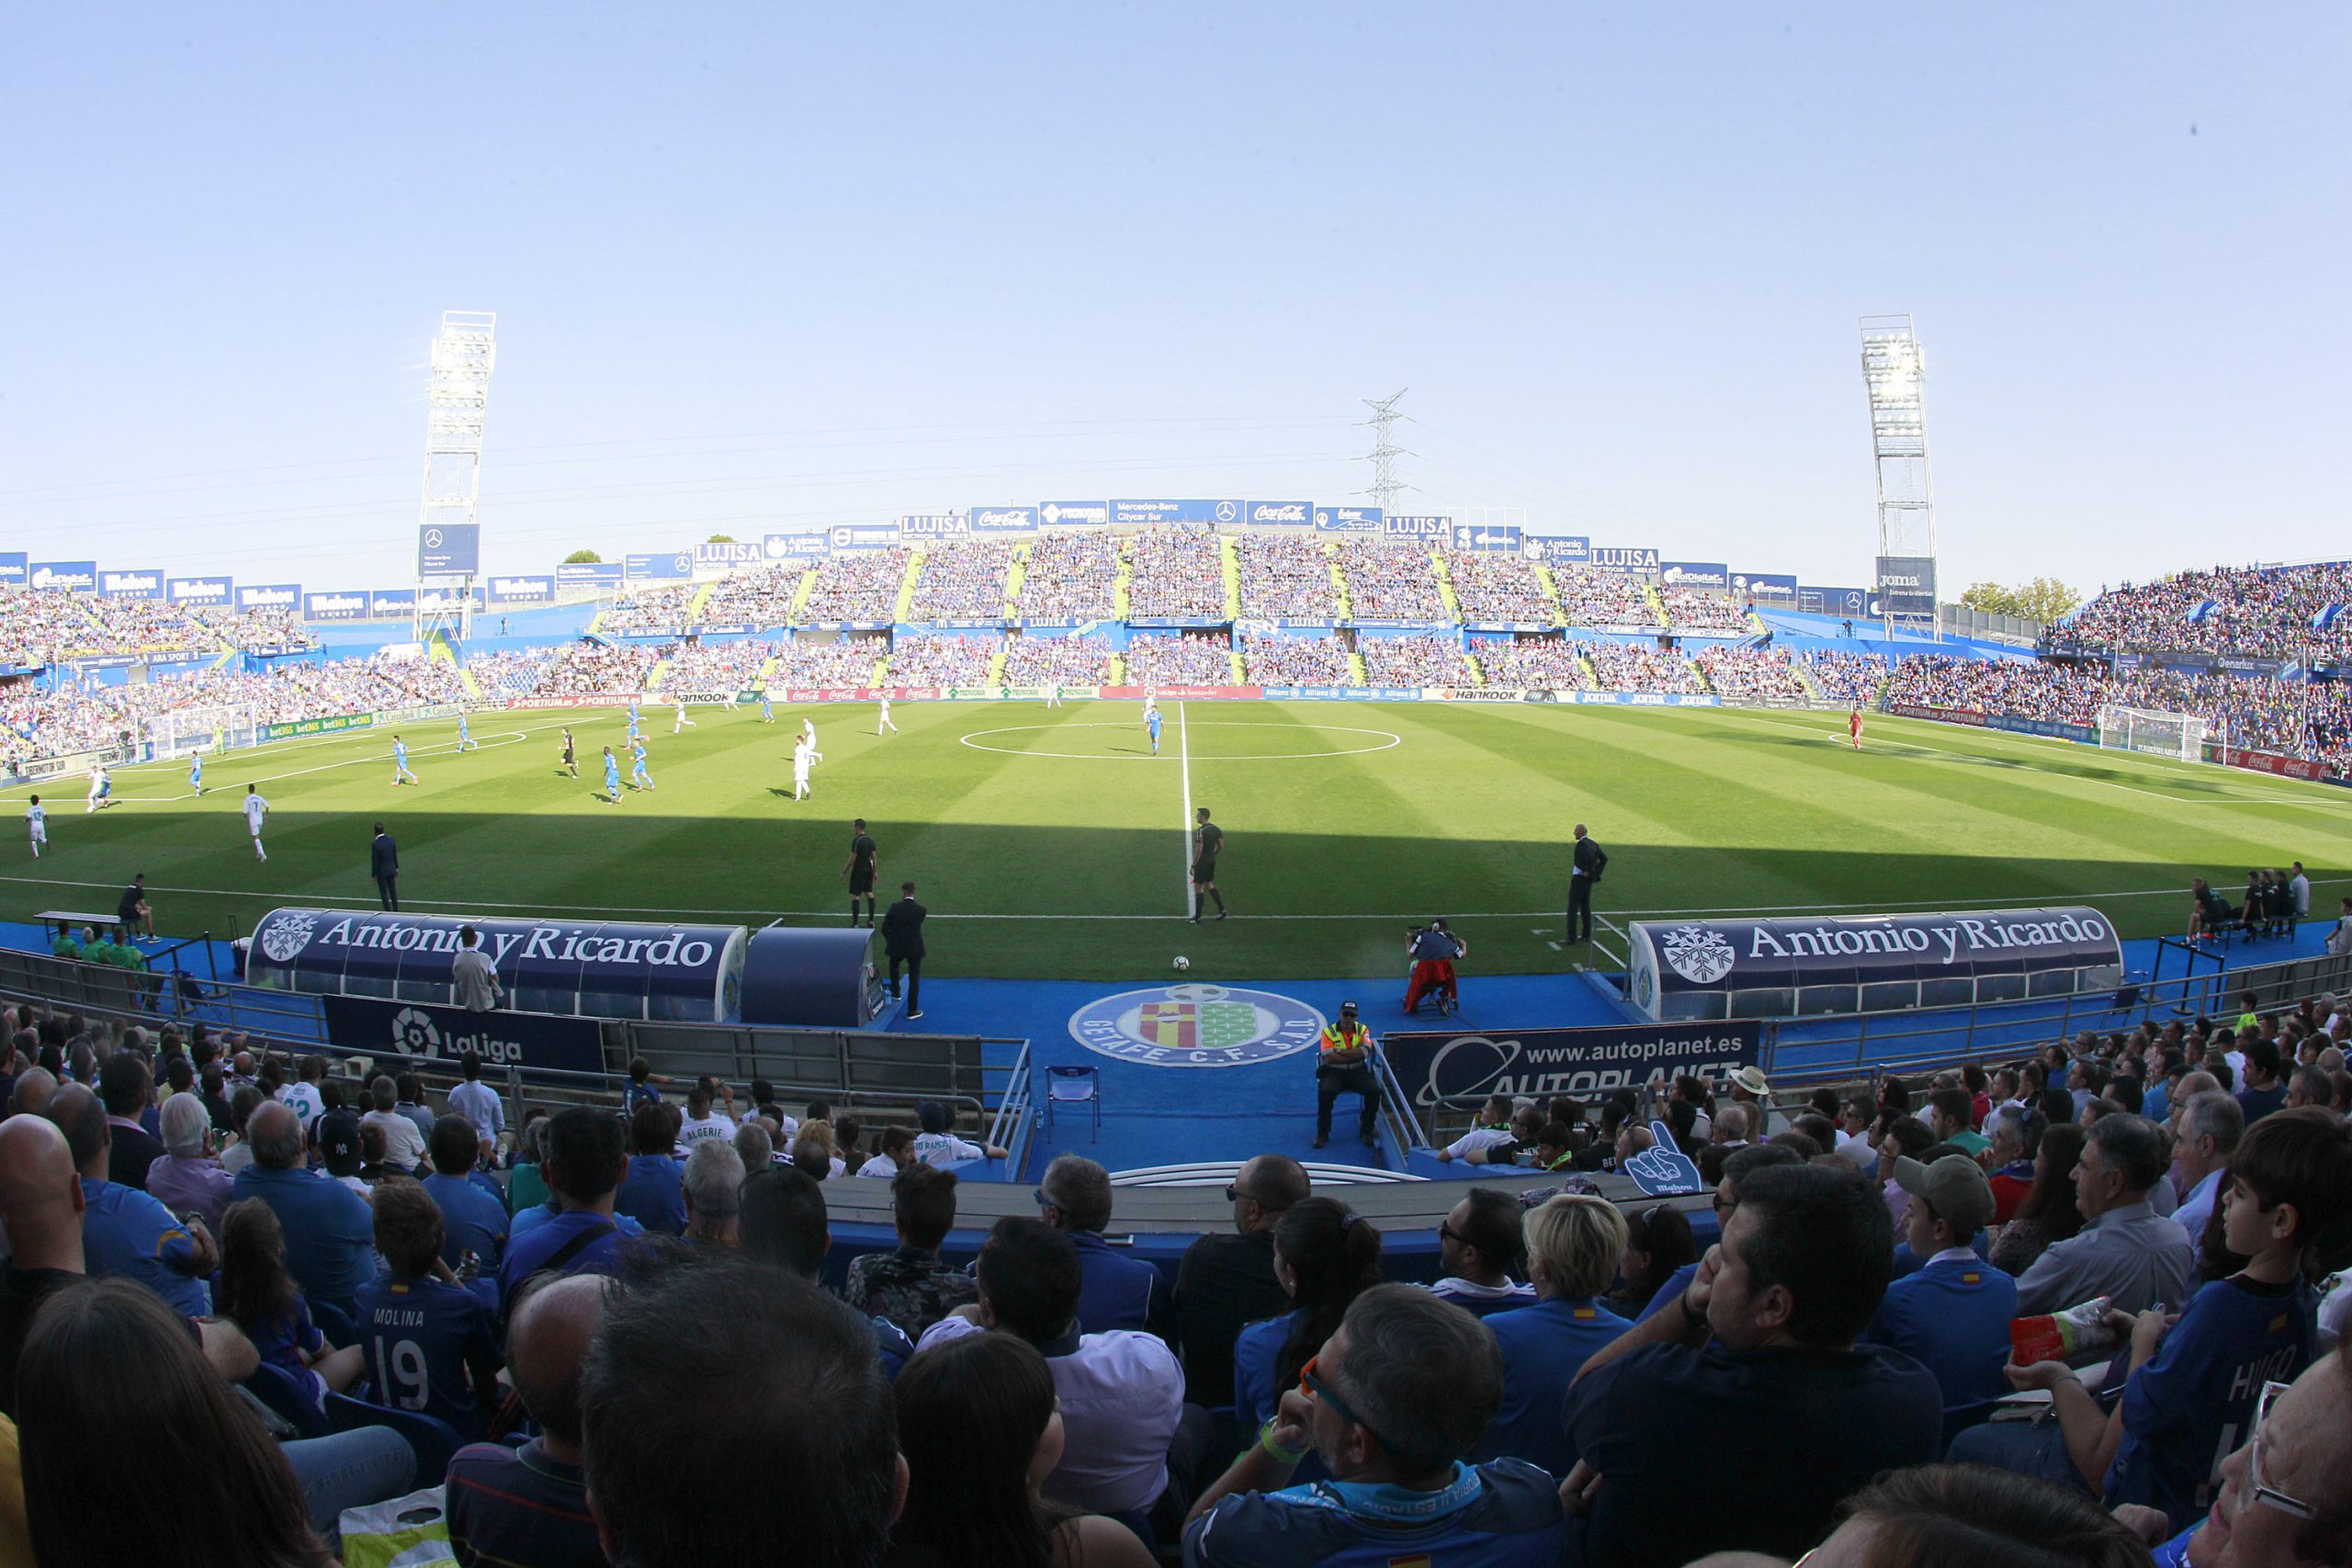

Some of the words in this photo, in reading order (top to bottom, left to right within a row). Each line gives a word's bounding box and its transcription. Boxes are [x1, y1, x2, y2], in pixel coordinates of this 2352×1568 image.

[1117, 502, 1179, 511] Mercedes-Benz
[1254, 505, 1306, 521] Coca-Cola
[902, 517, 967, 533] LUJISA
[978, 511, 1031, 526] Coca-Cola
[1117, 513, 1146, 522] Citycar
[1148, 513, 1162, 521] Sur
[1385, 517, 1451, 534] LUJISA
[788, 536, 823, 546] Antonio
[1546, 539, 1582, 548] Antonio
[694, 545, 761, 561] LUJISA
[788, 545, 794, 554] y
[795, 544, 829, 552] Ricardo
[1546, 548, 1552, 558] y
[1553, 547, 1587, 556] Ricardo
[1591, 549, 1657, 566] LUJISA
[105, 573, 156, 591] Mahou
[174, 581, 226, 597] Mahou
[495, 579, 548, 594] Mahou
[242, 588, 295, 604] Mahou
[311, 595, 364, 611] Mahou
[1030, 618, 1067, 627] LUJISA
[1288, 618, 1326, 627] LUJISA
[153, 653, 166, 662] ARA
[168, 652, 190, 661] SPORT
[792, 691, 820, 701] Coca-Cola
[829, 690, 855, 700] Coca-Cola
[868, 690, 896, 699] Coca-Cola
[906, 689, 933, 699] Coca-Cola
[296, 722, 319, 732] bet365
[322, 719, 345, 728] bet365
[349, 716, 370, 726] bet365
[269, 726, 293, 737] bet365
[2217, 749, 2241, 764] Coa-Cola
[2248, 754, 2273, 770] Coca-Cola
[25, 761, 55, 776] TIBERMOTOR
[57, 761, 66, 770] SUR
[2284, 761, 2310, 776] Coca-Cola
[319, 918, 485, 953] Antonio
[491, 932, 525, 965] y
[520, 927, 713, 967] Ricardo
[1749, 923, 1929, 959] Antonio
[1928, 927, 1957, 964] y
[1957, 914, 2106, 950] Ricardo
[444, 1031, 522, 1063] LaLiga
[1082, 1020, 1170, 1062] GETAFE
[1526, 1035, 1743, 1065] www.autoplanet.es
[689, 1128, 722, 1142] ALGERIE
[1523, 1147, 1540, 1156] BEN
[1657, 1184, 1693, 1192] Mahou
[374, 1307, 424, 1327] MOLINA
[374, 1335, 430, 1411] 19
[2227, 1343, 2297, 1402] HUGO
